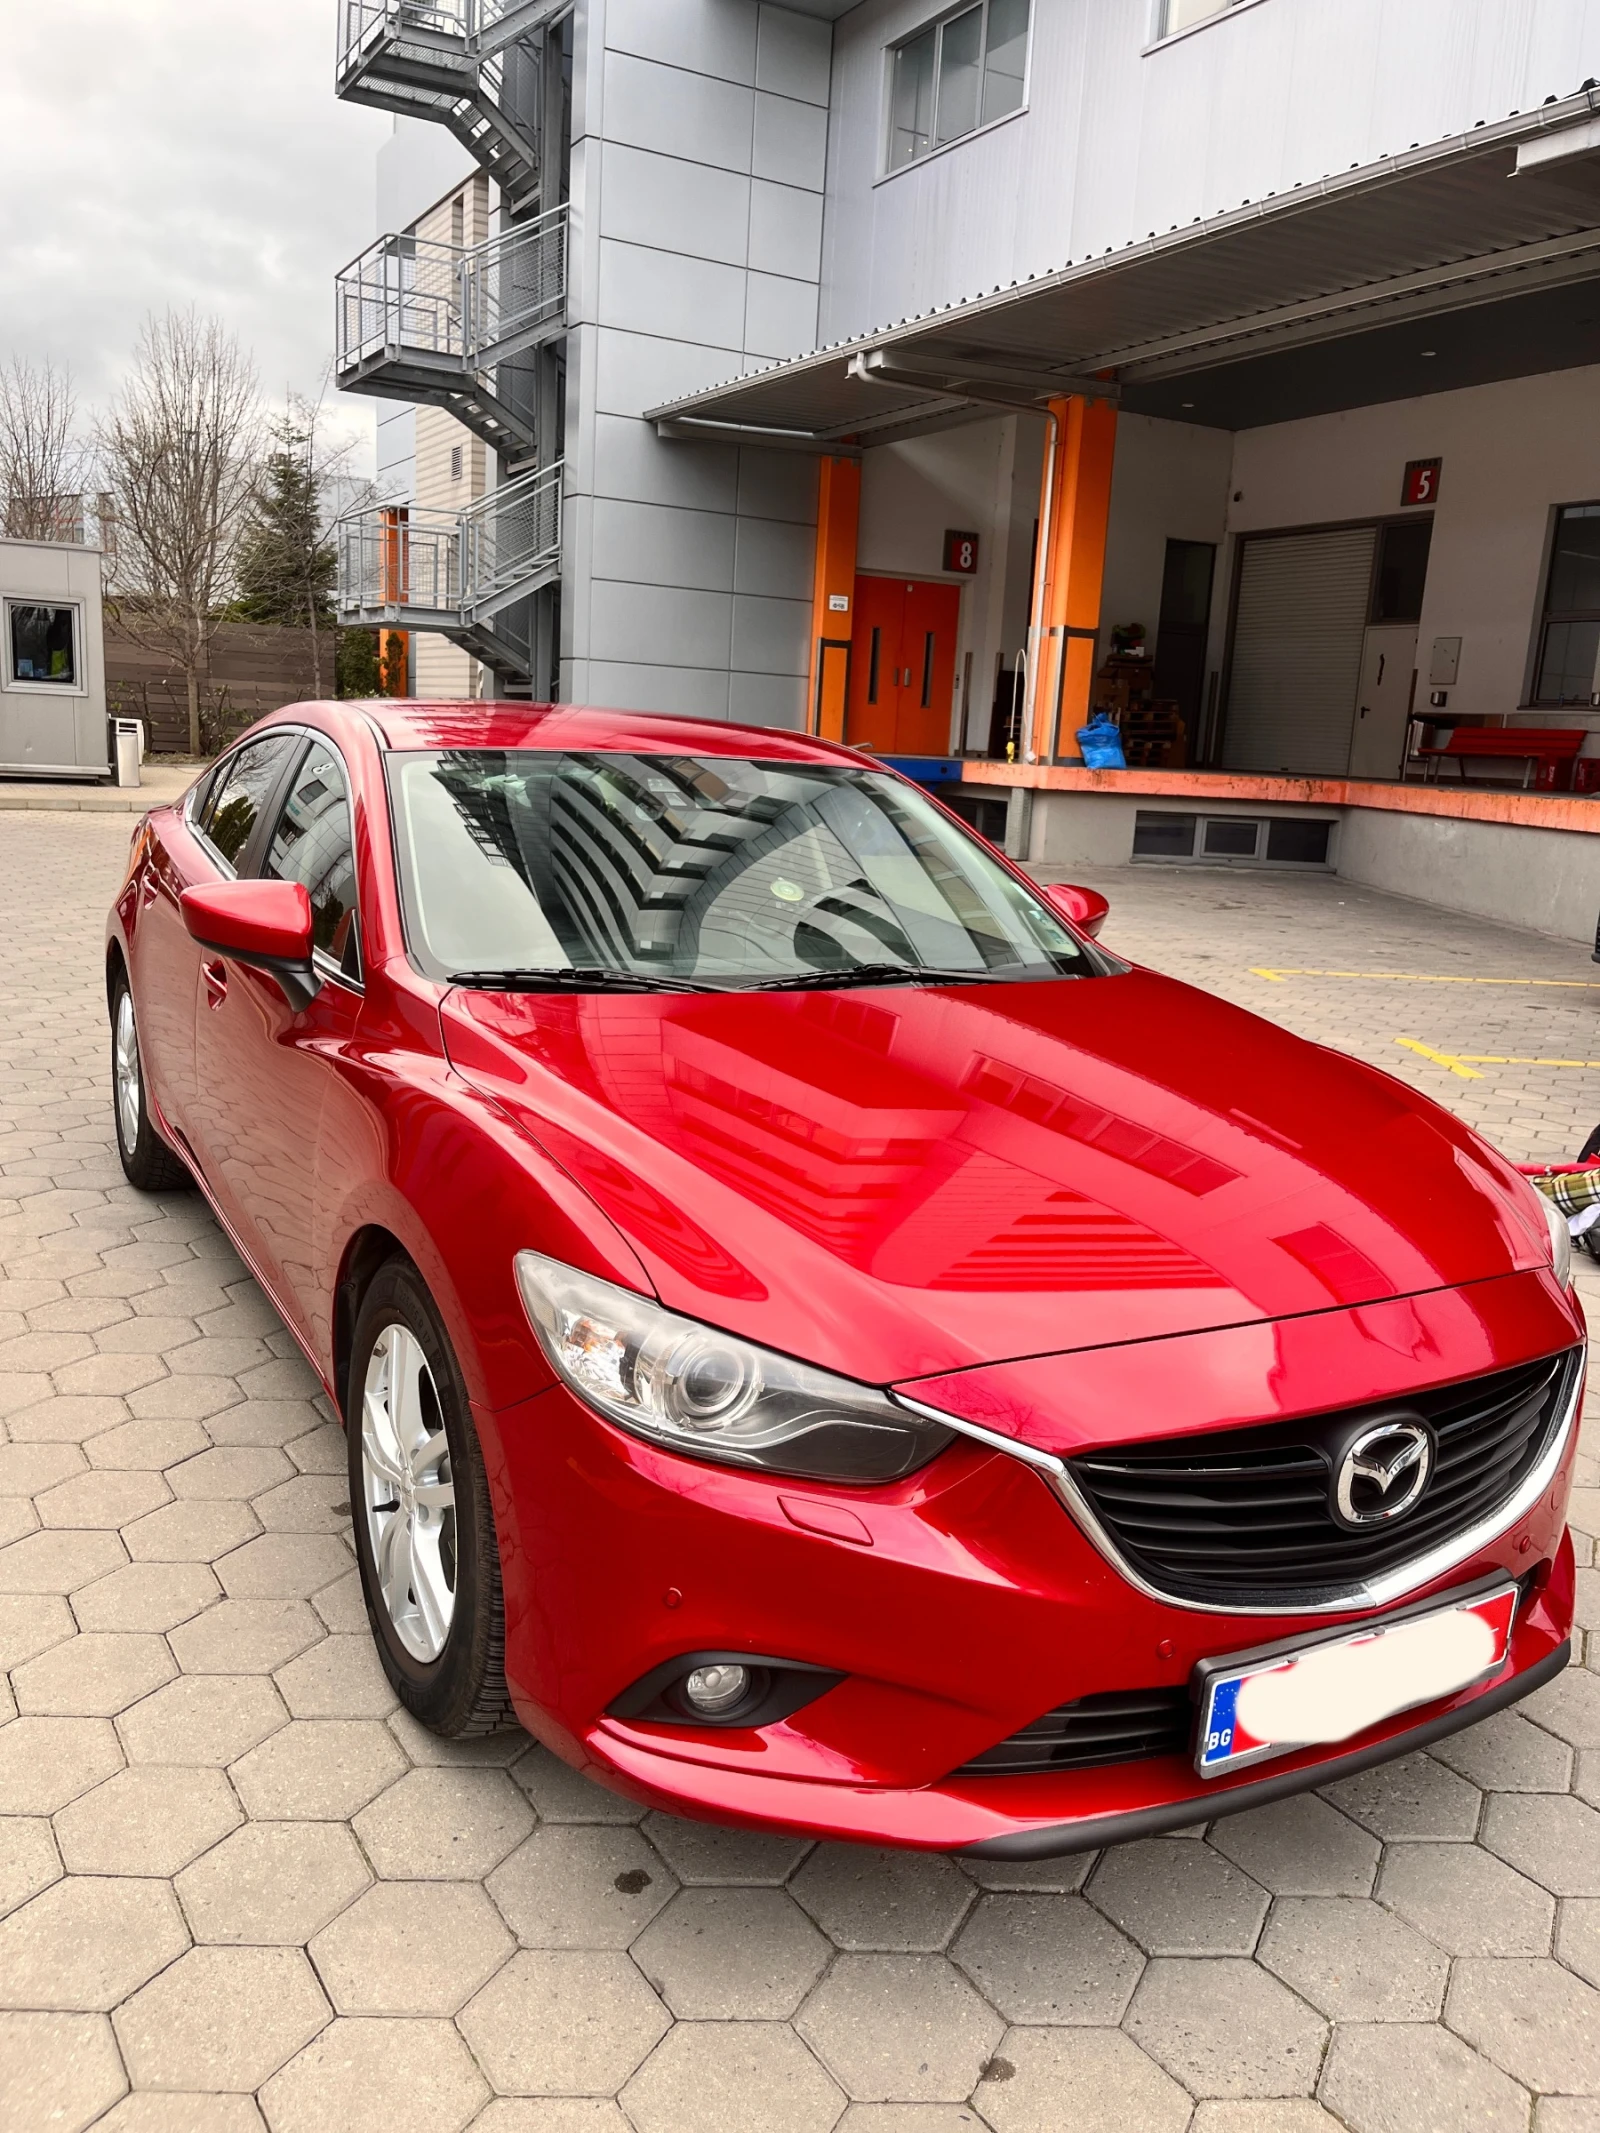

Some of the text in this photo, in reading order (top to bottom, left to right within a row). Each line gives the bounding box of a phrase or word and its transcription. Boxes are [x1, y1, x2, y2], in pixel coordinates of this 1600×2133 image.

[1416, 470, 1432, 499] 5
[959, 541, 973, 568] 8
[1208, 1727, 1232, 1751] BG
